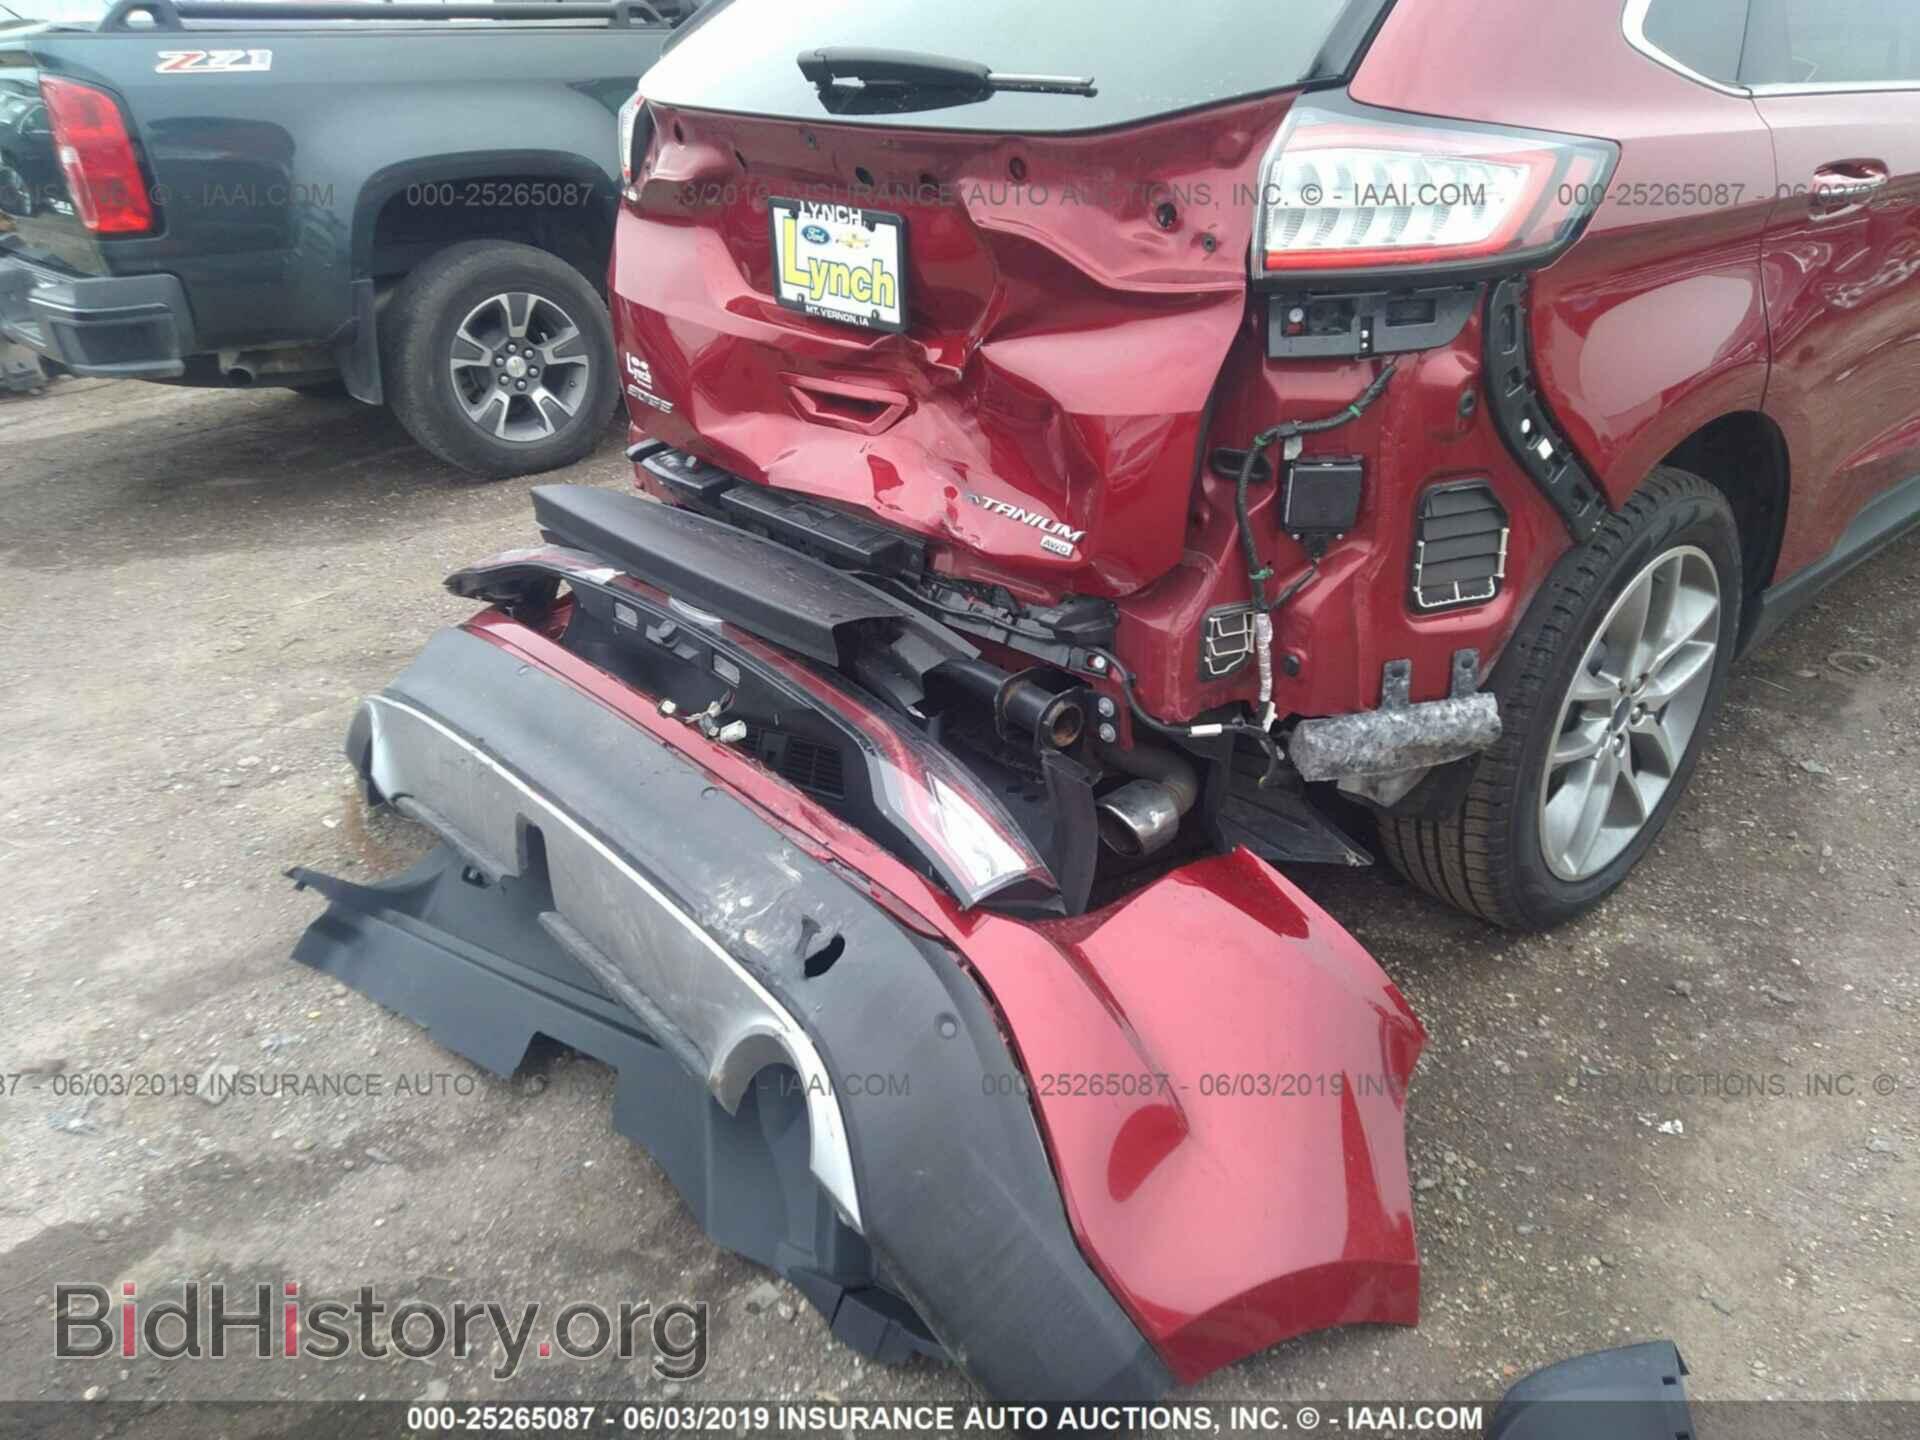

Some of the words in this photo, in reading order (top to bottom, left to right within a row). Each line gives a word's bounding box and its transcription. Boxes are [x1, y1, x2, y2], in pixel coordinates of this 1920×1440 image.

[800, 200, 864, 226] LYNCH
[783, 216, 895, 308] Lynch
[805, 304, 820, 316] MT.
[1043, 538, 1070, 553] AWD
